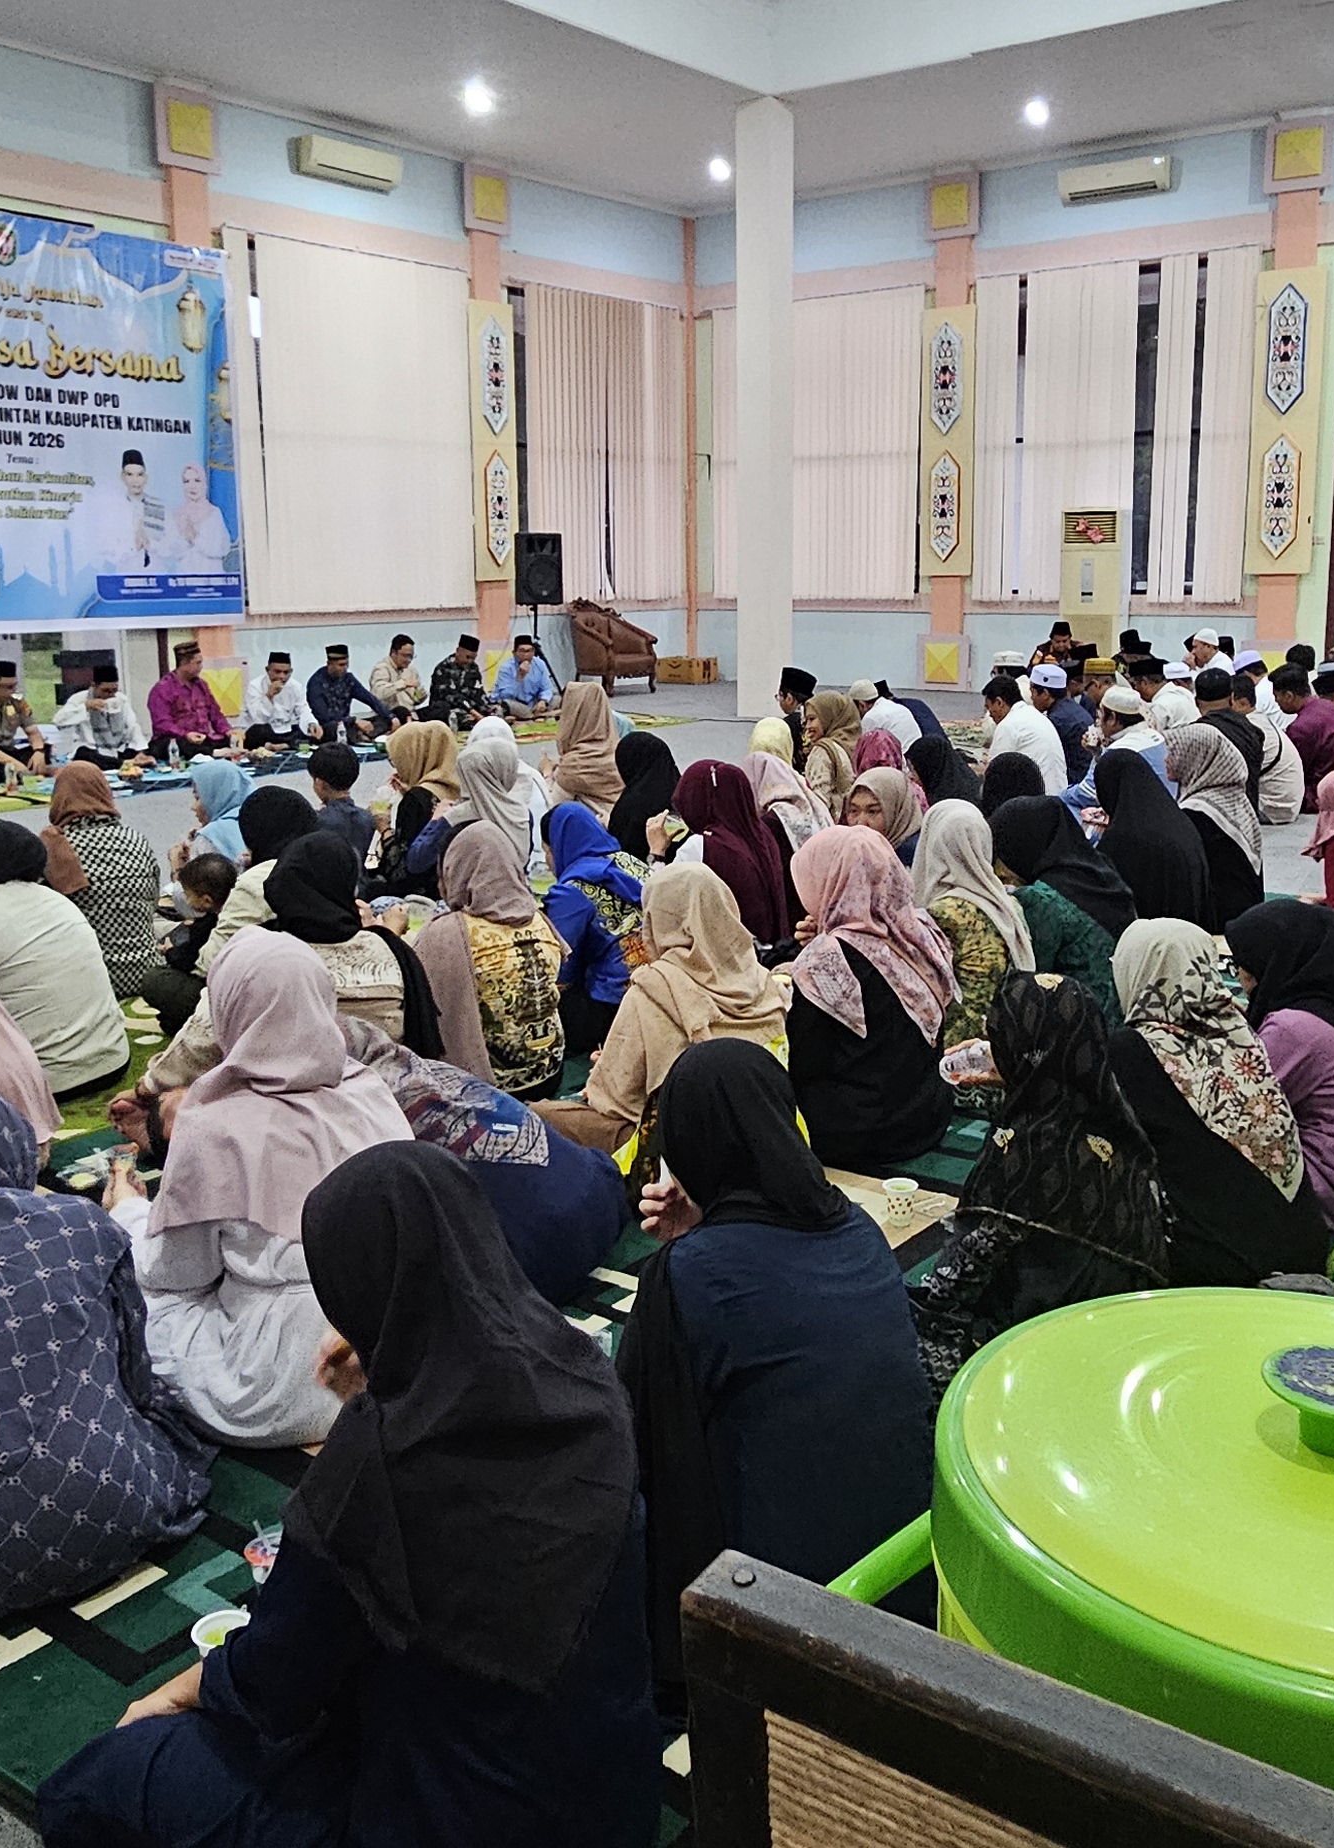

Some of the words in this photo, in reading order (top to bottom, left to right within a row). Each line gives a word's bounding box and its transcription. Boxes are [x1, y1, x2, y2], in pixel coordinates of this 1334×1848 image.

[43, 324, 186, 383] Bersama
[25, 386, 53, 404] DAN
[58, 388, 89, 406] DWP
[94, 392, 120, 408] OPD
[45, 410, 123, 431] KABUPATEN
[127, 416, 192, 434] KATINGAN
[28, 431, 65, 448] 2026
